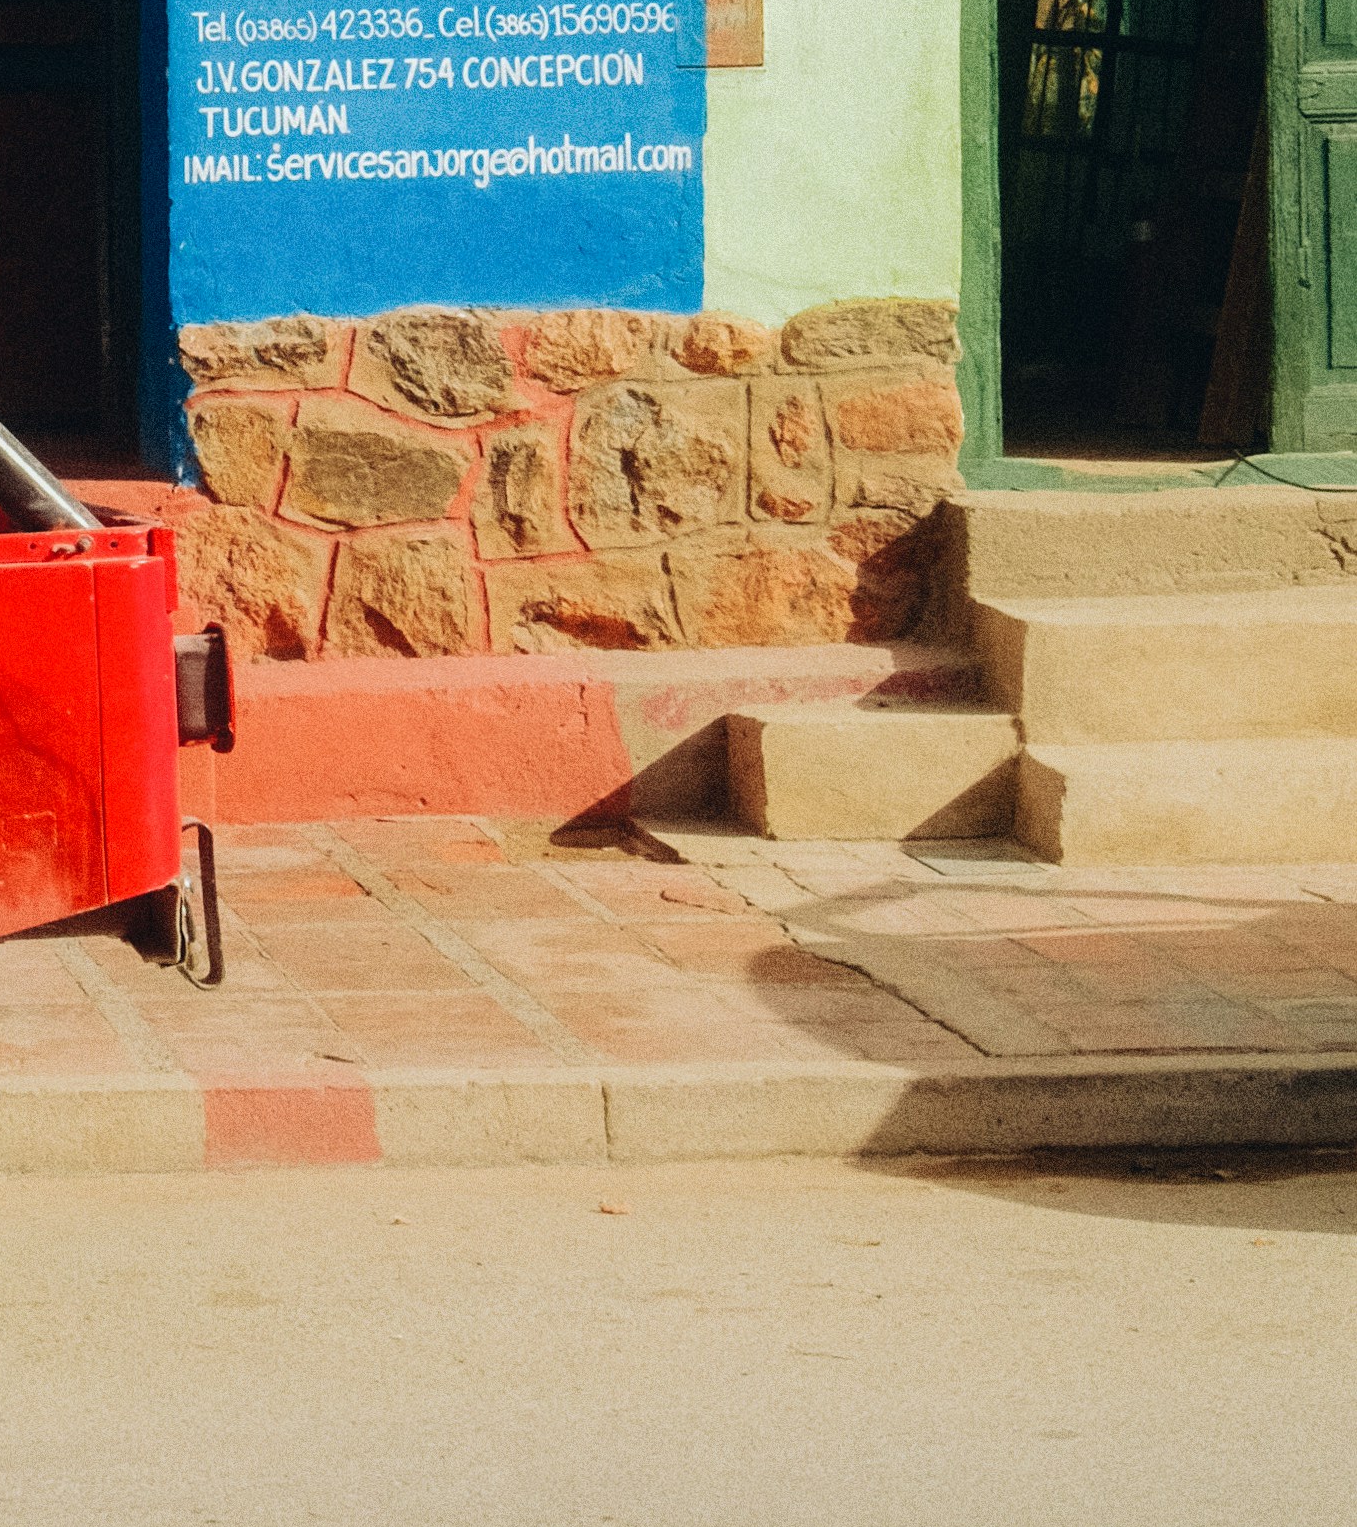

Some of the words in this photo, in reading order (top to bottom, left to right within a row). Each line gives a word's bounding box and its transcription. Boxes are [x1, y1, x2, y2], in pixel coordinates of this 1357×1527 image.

[403, 56, 454, 90] 754
[462, 48, 644, 89] CONCEPCIÓN
[199, 101, 349, 138] TUCUMÁN
